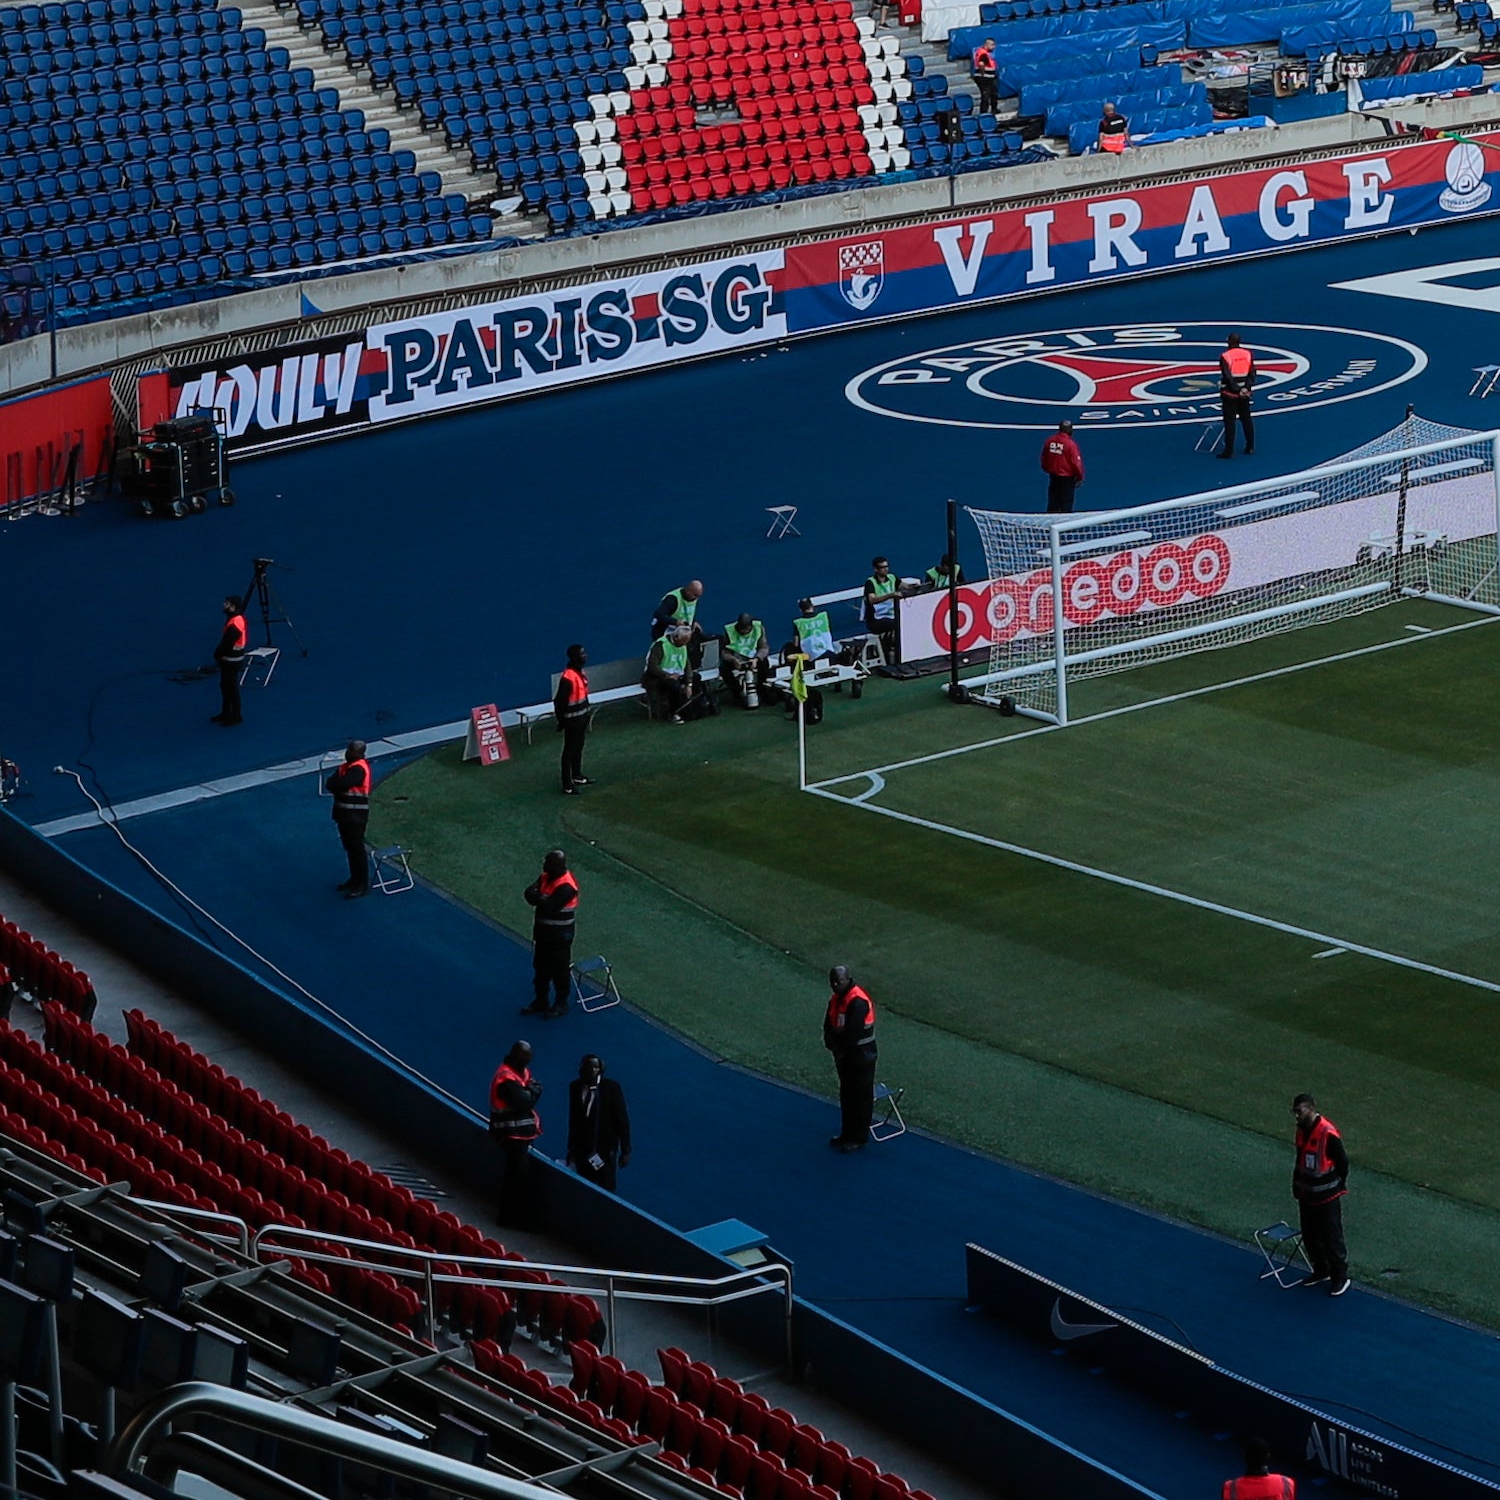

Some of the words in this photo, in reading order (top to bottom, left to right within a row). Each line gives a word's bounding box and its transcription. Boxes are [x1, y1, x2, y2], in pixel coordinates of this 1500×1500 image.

[879, 327, 1185, 386] PARIS
[1266, 358, 1378, 401] GERMAIN
[936, 538, 1229, 649] ooredoo
